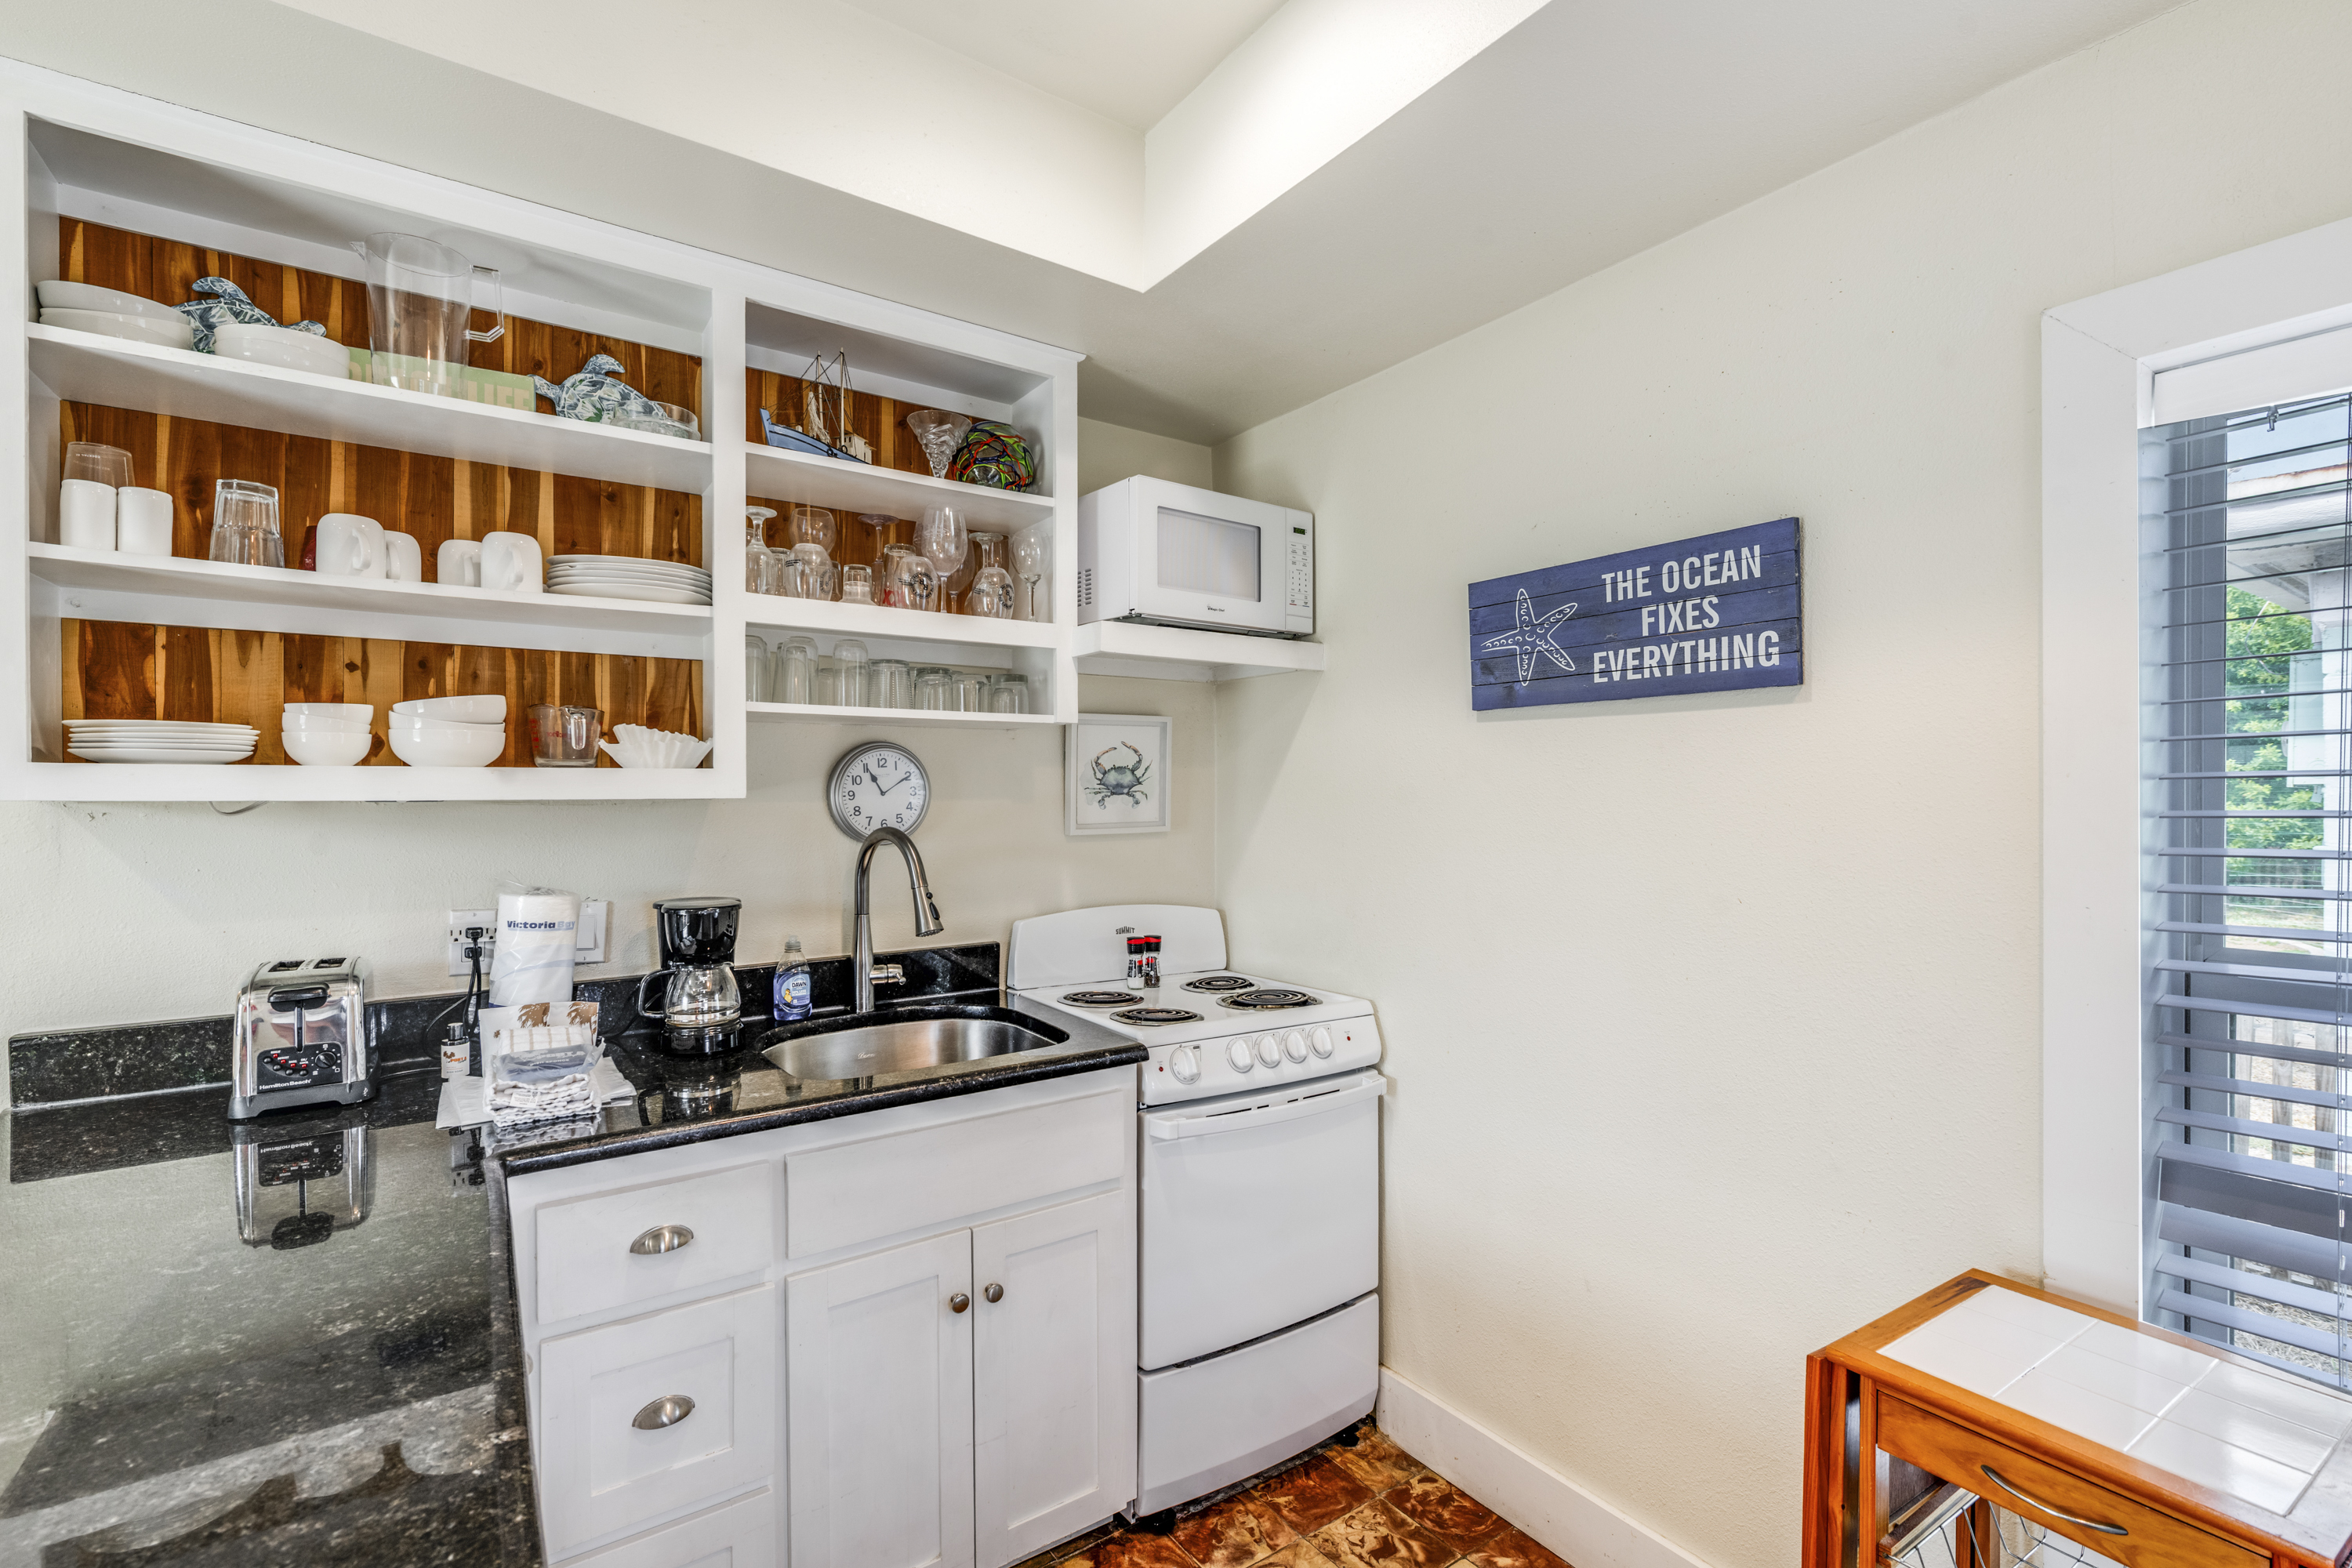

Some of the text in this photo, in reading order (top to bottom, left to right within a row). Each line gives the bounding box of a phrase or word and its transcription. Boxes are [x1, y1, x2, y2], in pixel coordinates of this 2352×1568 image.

[1602, 545, 1761, 603] THE OCEAN
[1642, 595, 1720, 637] FIXES
[1593, 630, 1780, 684] EVERYTHING
[877, 757, 887, 768] 12
[862, 763, 868, 773] 11
[851, 775, 862, 786] 10
[904, 771, 912, 781] 2
[848, 790, 855, 800] 9
[909, 786, 917, 796] 3
[853, 806, 862, 816] 8
[906, 801, 913, 811] 4
[866, 816, 873, 826] 7
[895, 813, 903, 823] 5
[507, 920, 575, 930] Victoria Bay
[1116, 926, 1135, 935] SUMMIT
